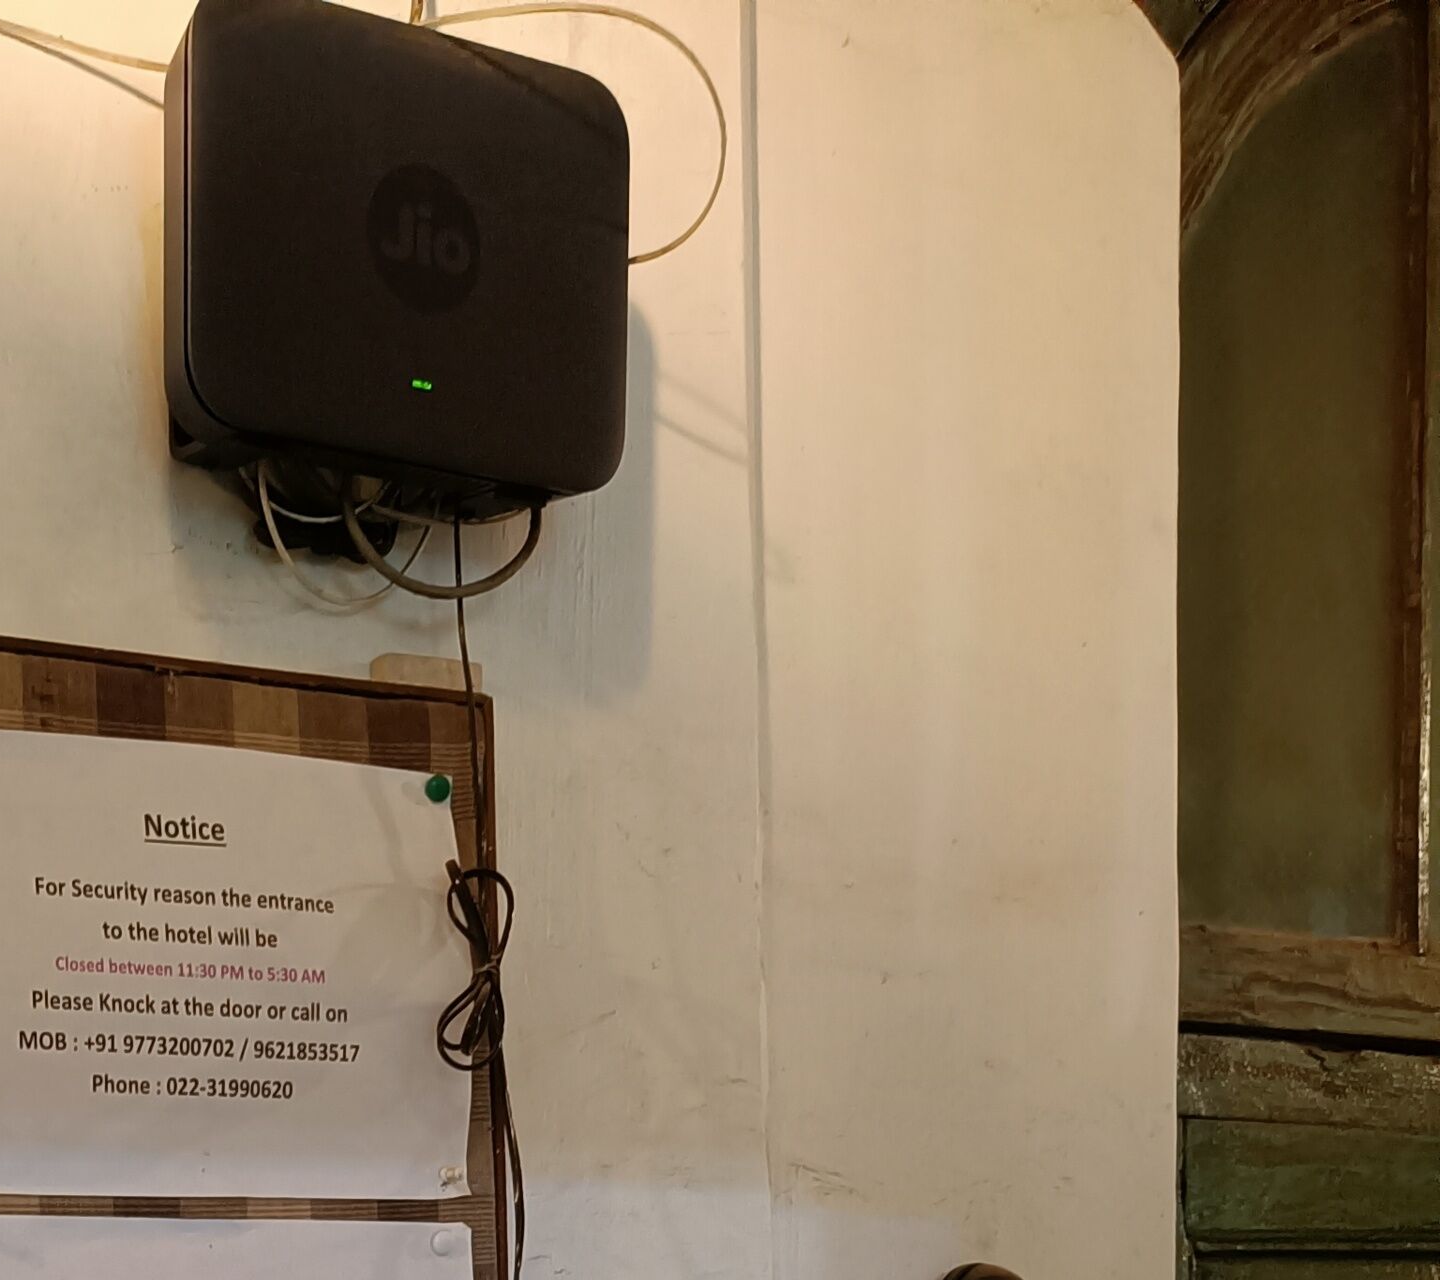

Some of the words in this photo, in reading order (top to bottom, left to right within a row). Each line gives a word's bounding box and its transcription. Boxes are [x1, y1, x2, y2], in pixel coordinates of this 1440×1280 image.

[381, 201, 471, 274] Jio
[143, 812, 225, 841] Notice
[34, 875, 66, 896] For
[70, 877, 148, 906] Security
[152, 886, 216, 905] reason
[220, 886, 252, 908] the
[256, 892, 334, 914] entrance
[54, 954, 104, 973] Closed
[107, 957, 173, 977] between
[177, 961, 217, 979] 11:30
[219, 963, 244, 980] PM
[247, 965, 263, 981] to
[266, 965, 298, 983] 5:30
[300, 967, 326, 984] AM
[18, 1029, 67, 1051] MOB
[83, 1032, 118, 1053] +91
[122, 1034, 234, 1058] 9773200702
[252, 1039, 360, 1062] 9621853517
[91, 1072, 150, 1095] Phone
[165, 1076, 293, 1099] 022-31990620
